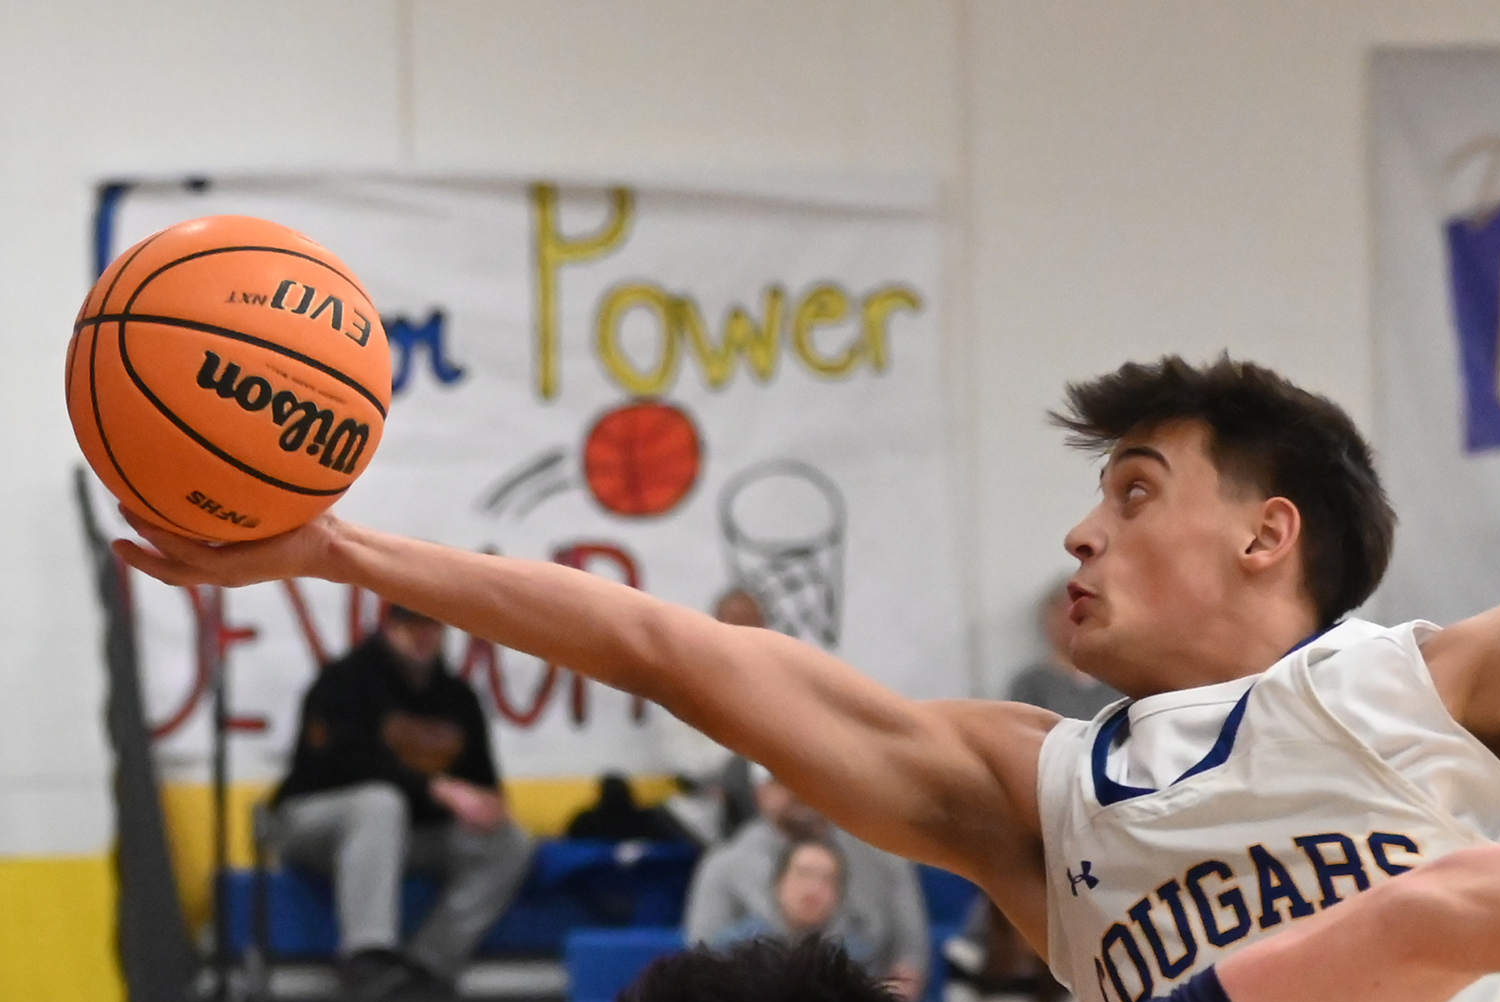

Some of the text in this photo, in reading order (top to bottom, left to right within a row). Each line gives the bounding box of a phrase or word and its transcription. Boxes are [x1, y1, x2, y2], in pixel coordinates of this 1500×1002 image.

[225, 291, 268, 306] NXT
[529, 183, 922, 401] Power
[195, 350, 370, 475] Wilson
[185, 490, 250, 526] NFHS
